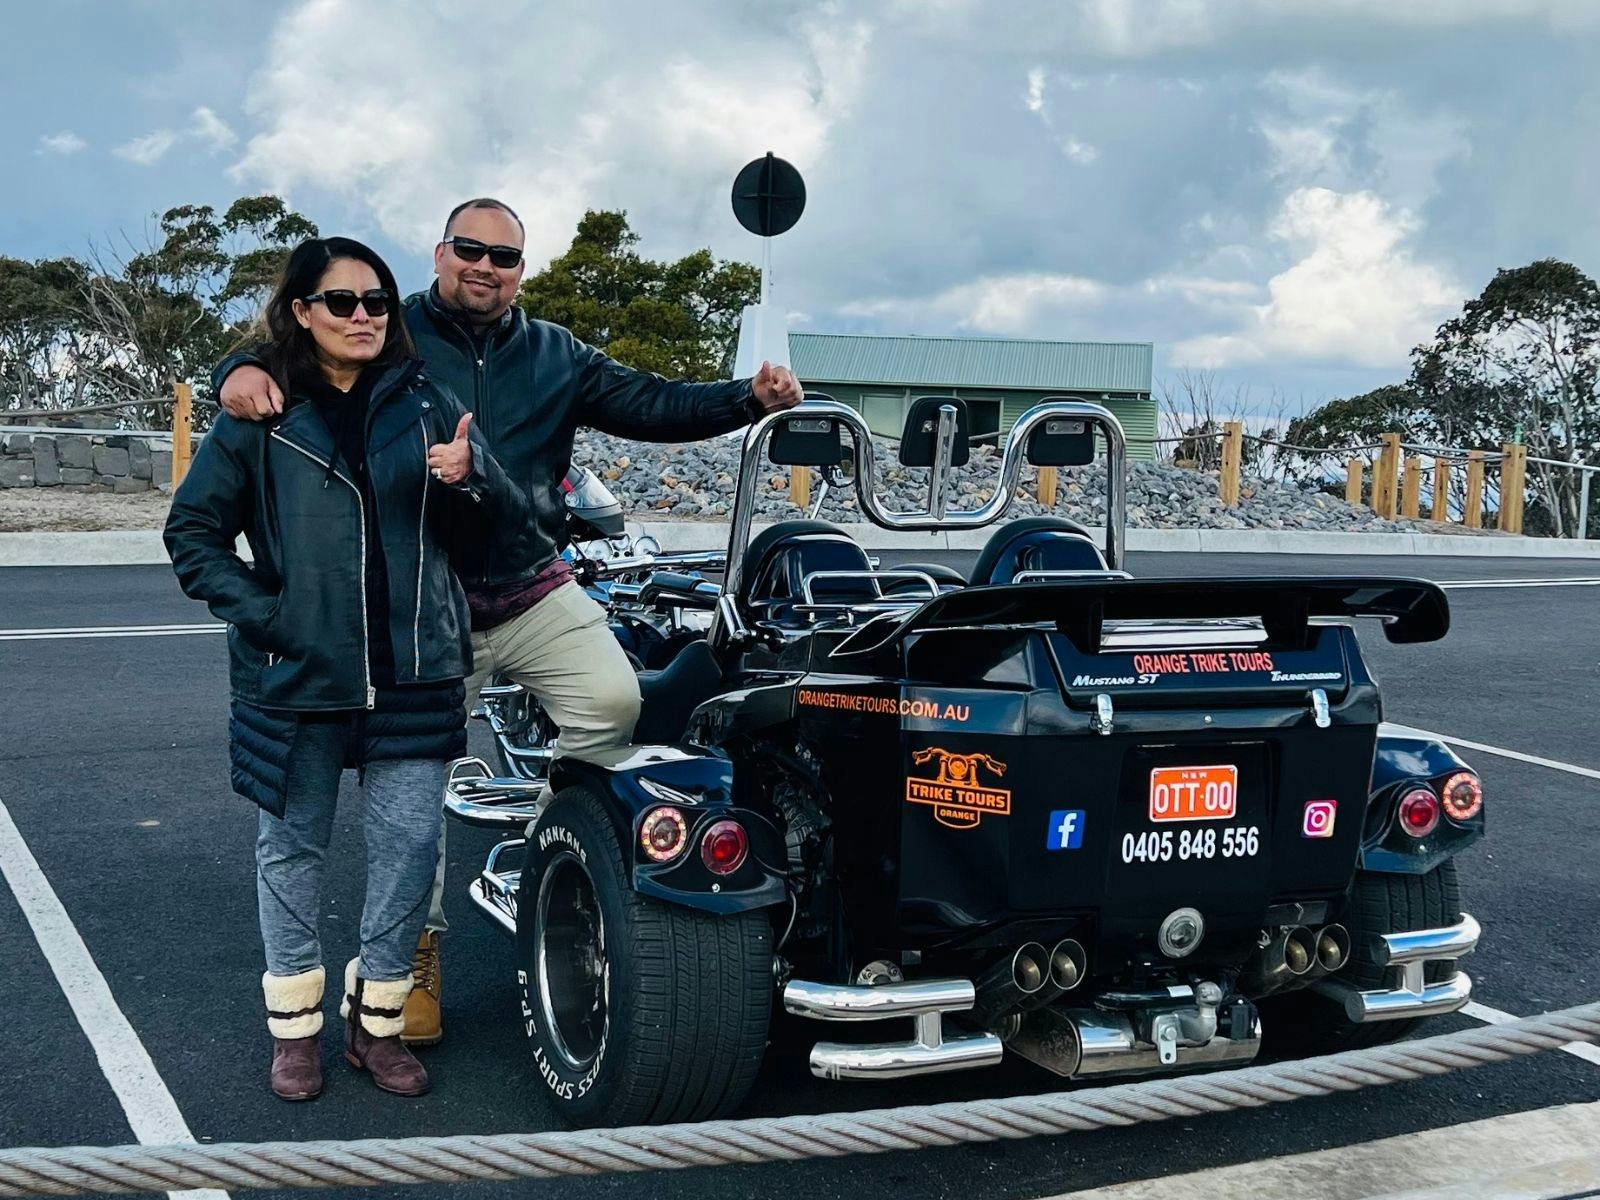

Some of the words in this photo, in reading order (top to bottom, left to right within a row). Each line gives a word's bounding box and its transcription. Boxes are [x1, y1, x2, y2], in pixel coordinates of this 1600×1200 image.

[1133, 654, 1189, 674] ORANGE
[1189, 653, 1230, 672] TRIKE
[1230, 652, 1274, 672] TOURS
[1137, 674, 1160, 685] ST
[798, 690, 970, 722] ORANGETRIKETOURS.COM.AU
[911, 784, 953, 801] TRIKE
[956, 789, 1005, 808] TOURS
[940, 809, 976, 821] ORANGE
[1122, 832, 1174, 863] 0405
[1178, 829, 1216, 860] 848
[1222, 826, 1260, 857] 556
[533, 1046, 575, 1100] SPORT
